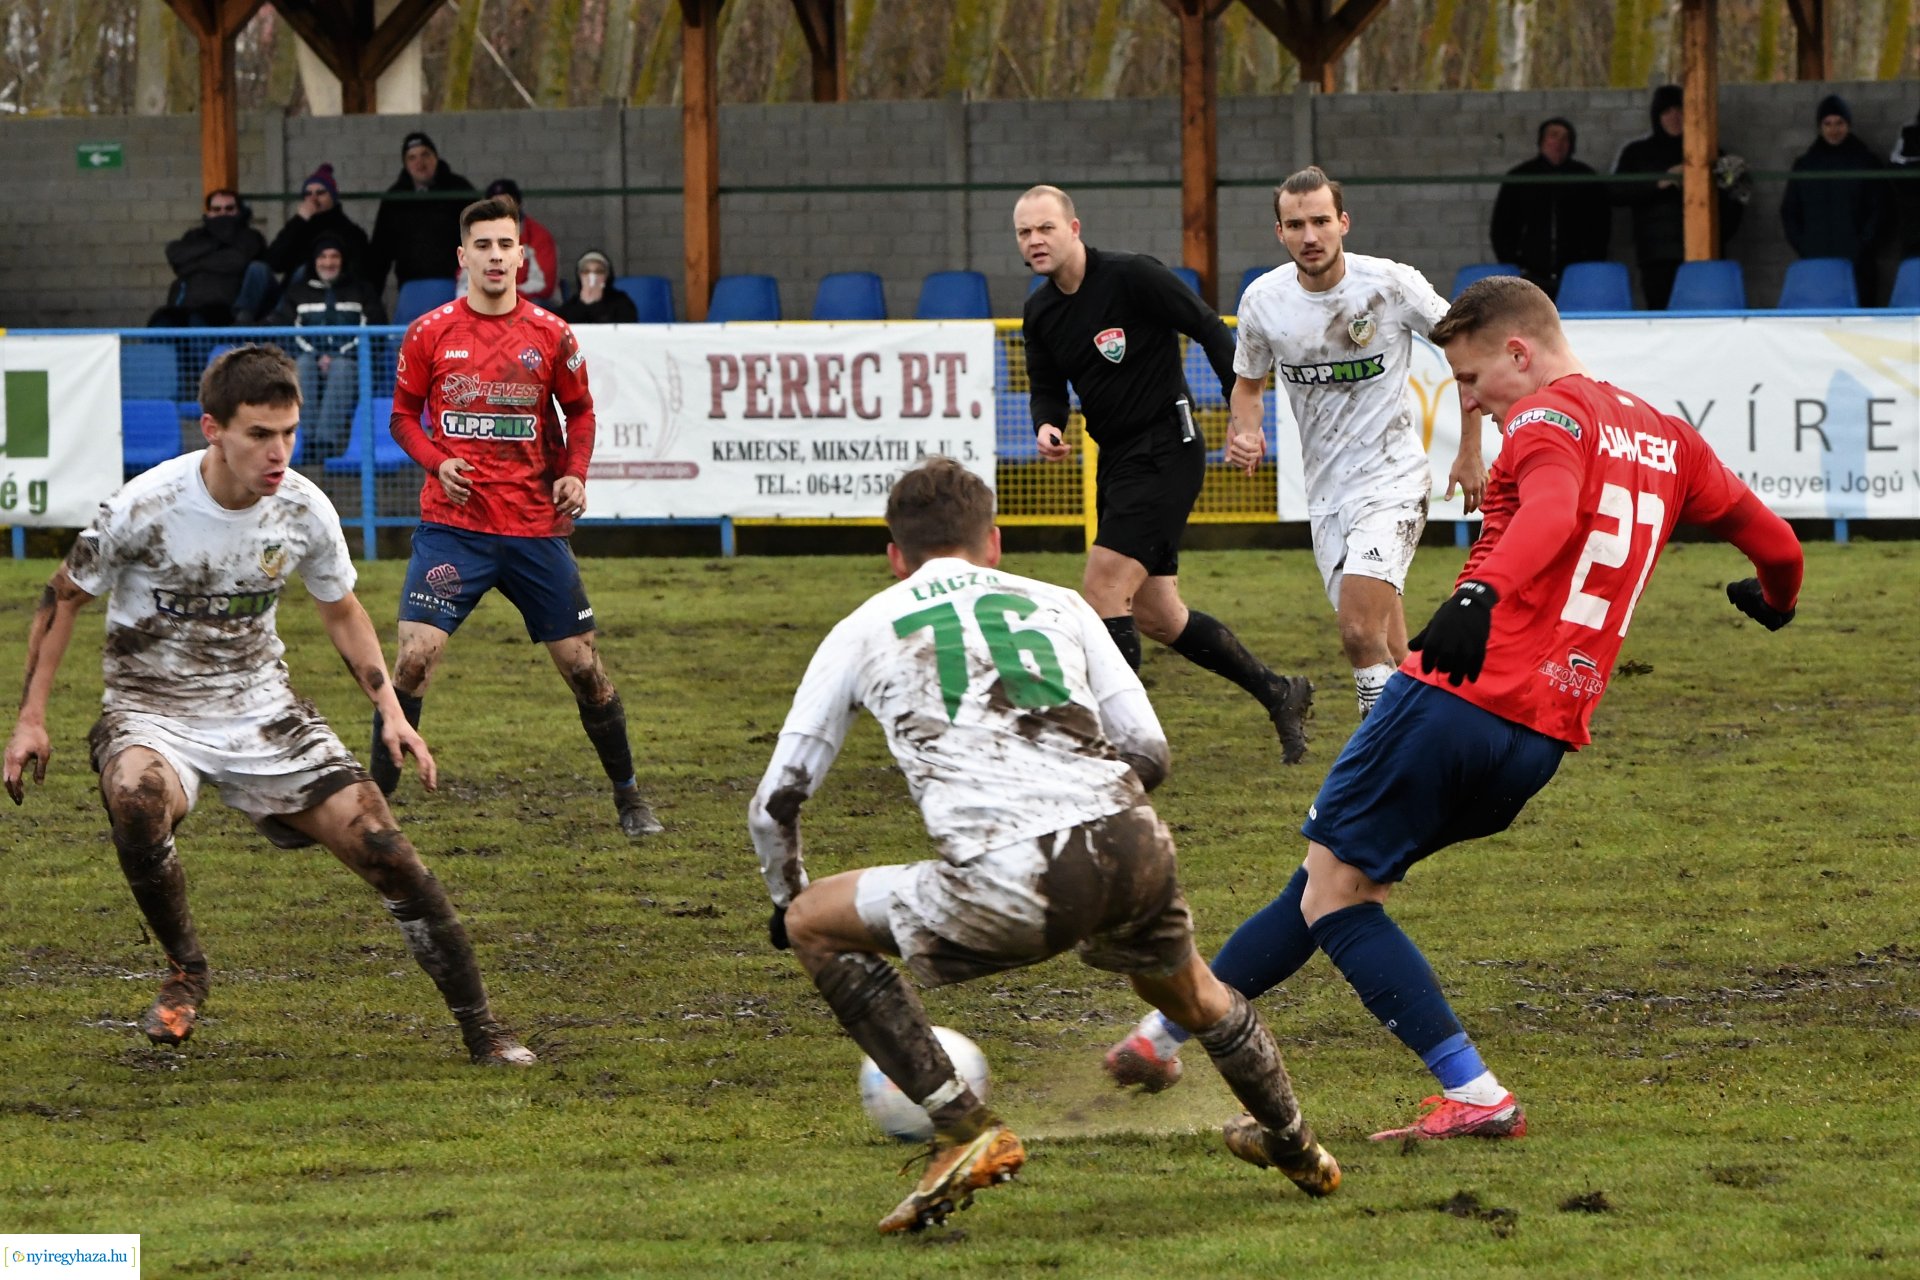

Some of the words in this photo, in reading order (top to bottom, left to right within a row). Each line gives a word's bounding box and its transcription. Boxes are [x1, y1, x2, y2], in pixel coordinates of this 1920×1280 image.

[444, 350, 469, 359] JAKO
[706, 352, 882, 419] PEREC
[898, 352, 982, 419] BT.
[712, 440, 806, 464] KEMECSE,
[812, 435, 909, 461] MIKSZÁTH
[963, 441, 980, 460] 5.
[1738, 470, 1831, 498] Megyei
[1841, 470, 1903, 498] Jogú
[1560, 482, 1665, 638] 27
